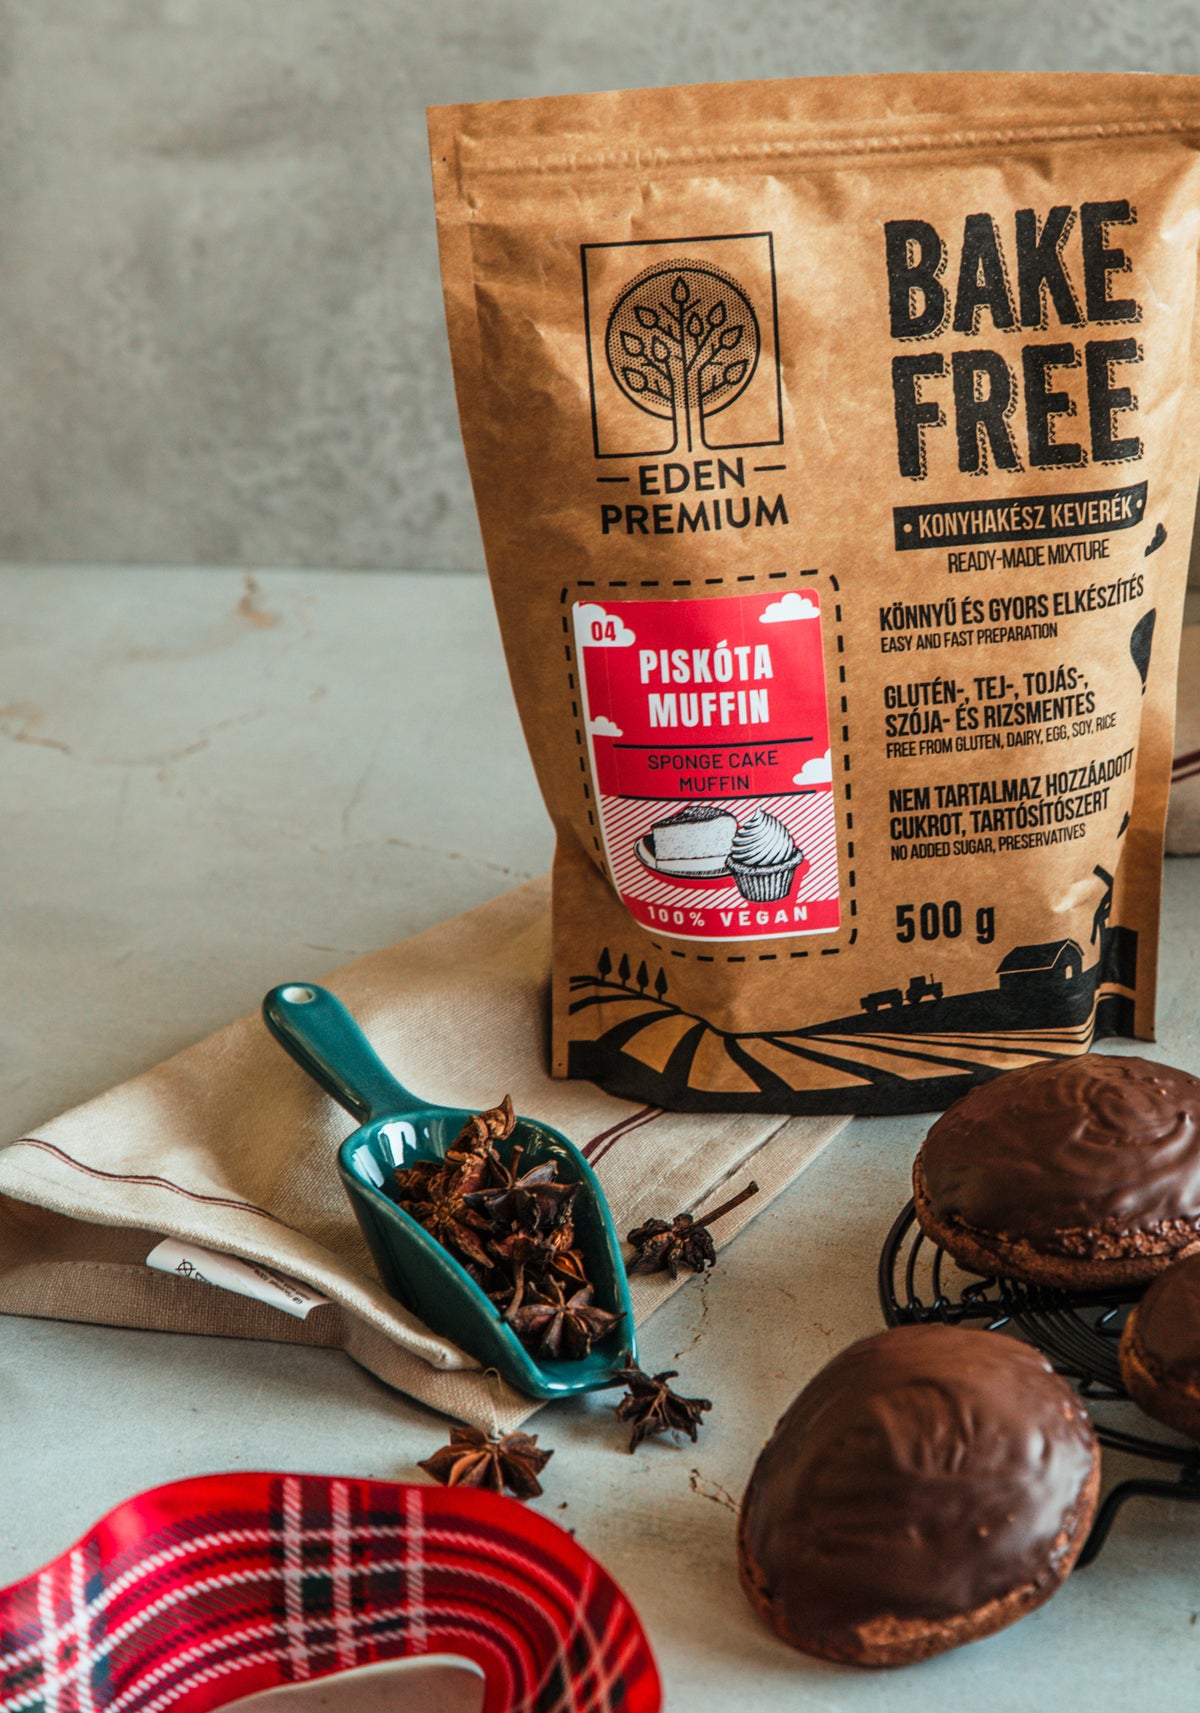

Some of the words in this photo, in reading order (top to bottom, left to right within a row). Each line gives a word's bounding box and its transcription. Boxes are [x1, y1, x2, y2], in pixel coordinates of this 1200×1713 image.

[884, 199, 1144, 342] BAKE
[892, 338, 1145, 482] FREE
[638, 456, 745, 496] EDEN
[600, 493, 789, 535] PREMIUM
[918, 503, 1046, 539] KONYHAKÉSZ
[1051, 493, 1133, 528] KEVERÉK
[948, 545, 1046, 574] READY-MADE
[1048, 538, 1110, 565] MIXTURE
[879, 597, 957, 632] KÖNNYŰ
[962, 596, 985, 625] ÉS
[988, 594, 1049, 622] GYORS
[1053, 573, 1145, 617] ELKÉSZÍTÉS
[590, 620, 617, 642] 04
[880, 635, 913, 653] EASY
[916, 633, 941, 651] AND
[943, 630, 974, 648] FAST
[977, 622, 1058, 645] PREPARATION
[639, 639, 774, 685] PISKÓTA
[648, 687, 770, 728] MUFFIN
[883, 676, 970, 710] GLUTÉN-,
[973, 675, 1020, 701] TEJ-,
[1023, 664, 1089, 697] TOJÁS-,
[885, 706, 950, 738] SZÓJA-
[955, 700, 979, 731] ÉS
[983, 691, 1096, 729] RIZSMENTES
[886, 740, 917, 759] FREE
[919, 737, 953, 757] FROM
[955, 733, 1005, 753] GLUTEN,
[1006, 729, 1044, 748] DAIRY,
[1046, 725, 1070, 743] EGG,
[1072, 718, 1094, 737] SOY,
[1096, 712, 1117, 732] RICE
[647, 752, 722, 771] SPONGE
[728, 750, 779, 768] CAKE
[889, 787, 931, 813] NEM
[934, 776, 1041, 809] TARTALMAZ
[1046, 747, 1135, 796] HOZZÁADOTT
[679, 775, 750, 793] MUFFIN
[890, 813, 967, 841] CUKROT,
[970, 787, 1111, 834] TARTÓSÍTÓSZERT
[891, 845, 908, 861] NO
[910, 842, 951, 860] ADDED
[953, 839, 996, 856] SUGAR,
[998, 823, 1086, 852] PRESERVATIVES
[647, 905, 706, 927] 100%
[719, 905, 808, 927] VEGAN
[896, 900, 962, 944] 500
[975, 905, 996, 945] g
